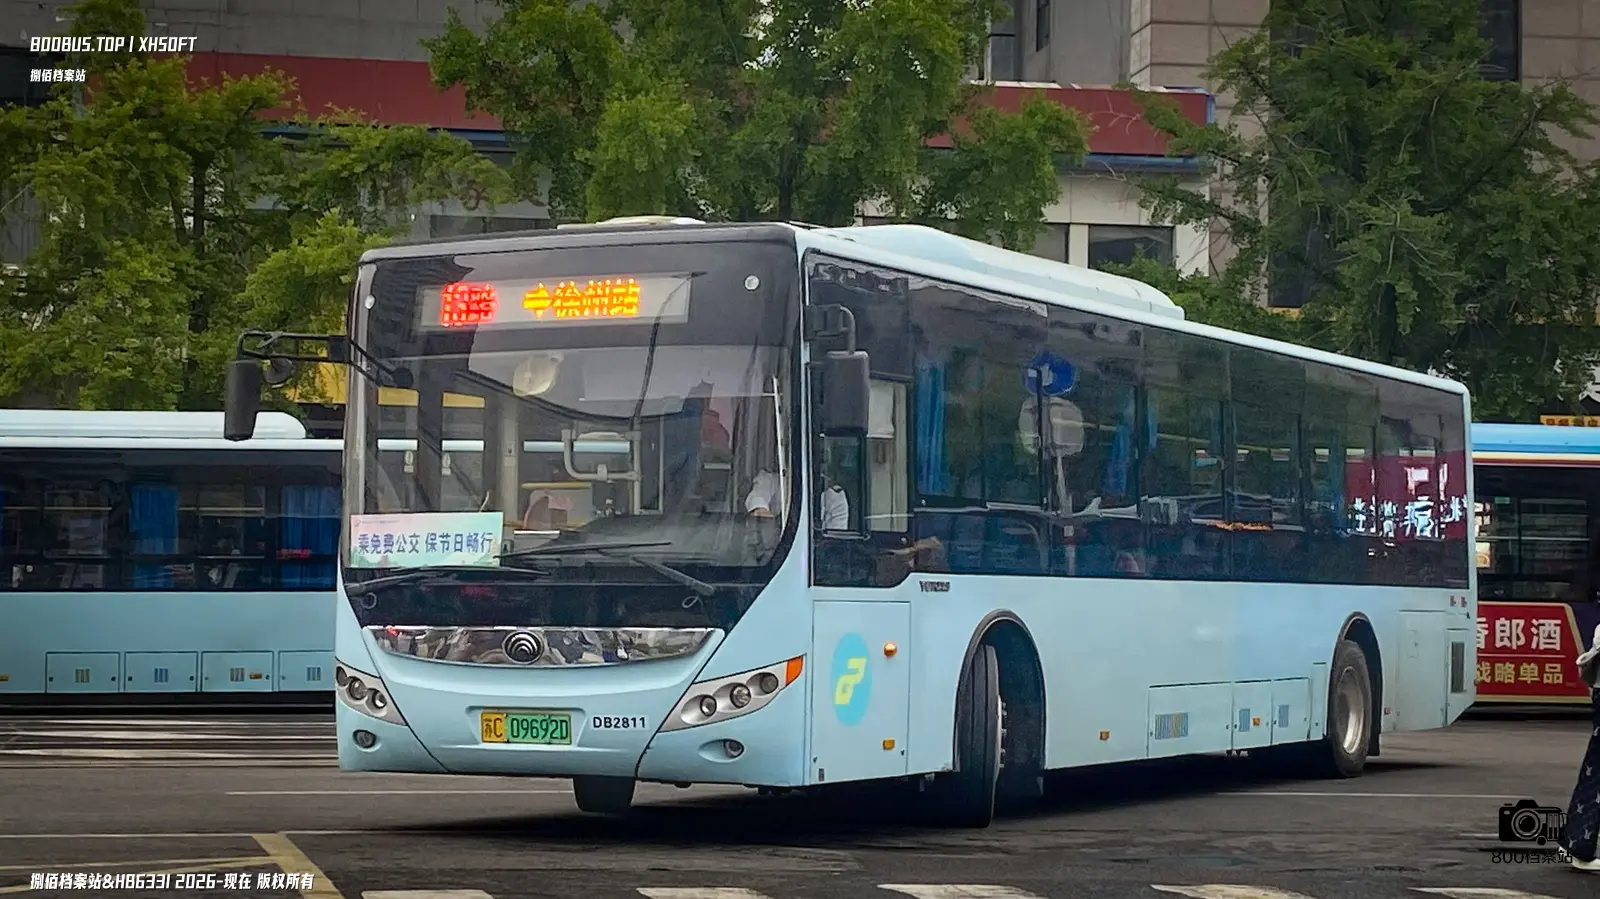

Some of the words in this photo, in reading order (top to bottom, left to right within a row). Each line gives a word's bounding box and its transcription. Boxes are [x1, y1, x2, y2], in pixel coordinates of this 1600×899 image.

[553, 278, 641, 318] 徐州站
[357, 532, 421, 554] 乘免费公交
[425, 532, 494, 554] 保节日畅行
[593, 716, 646, 729] DB2811
